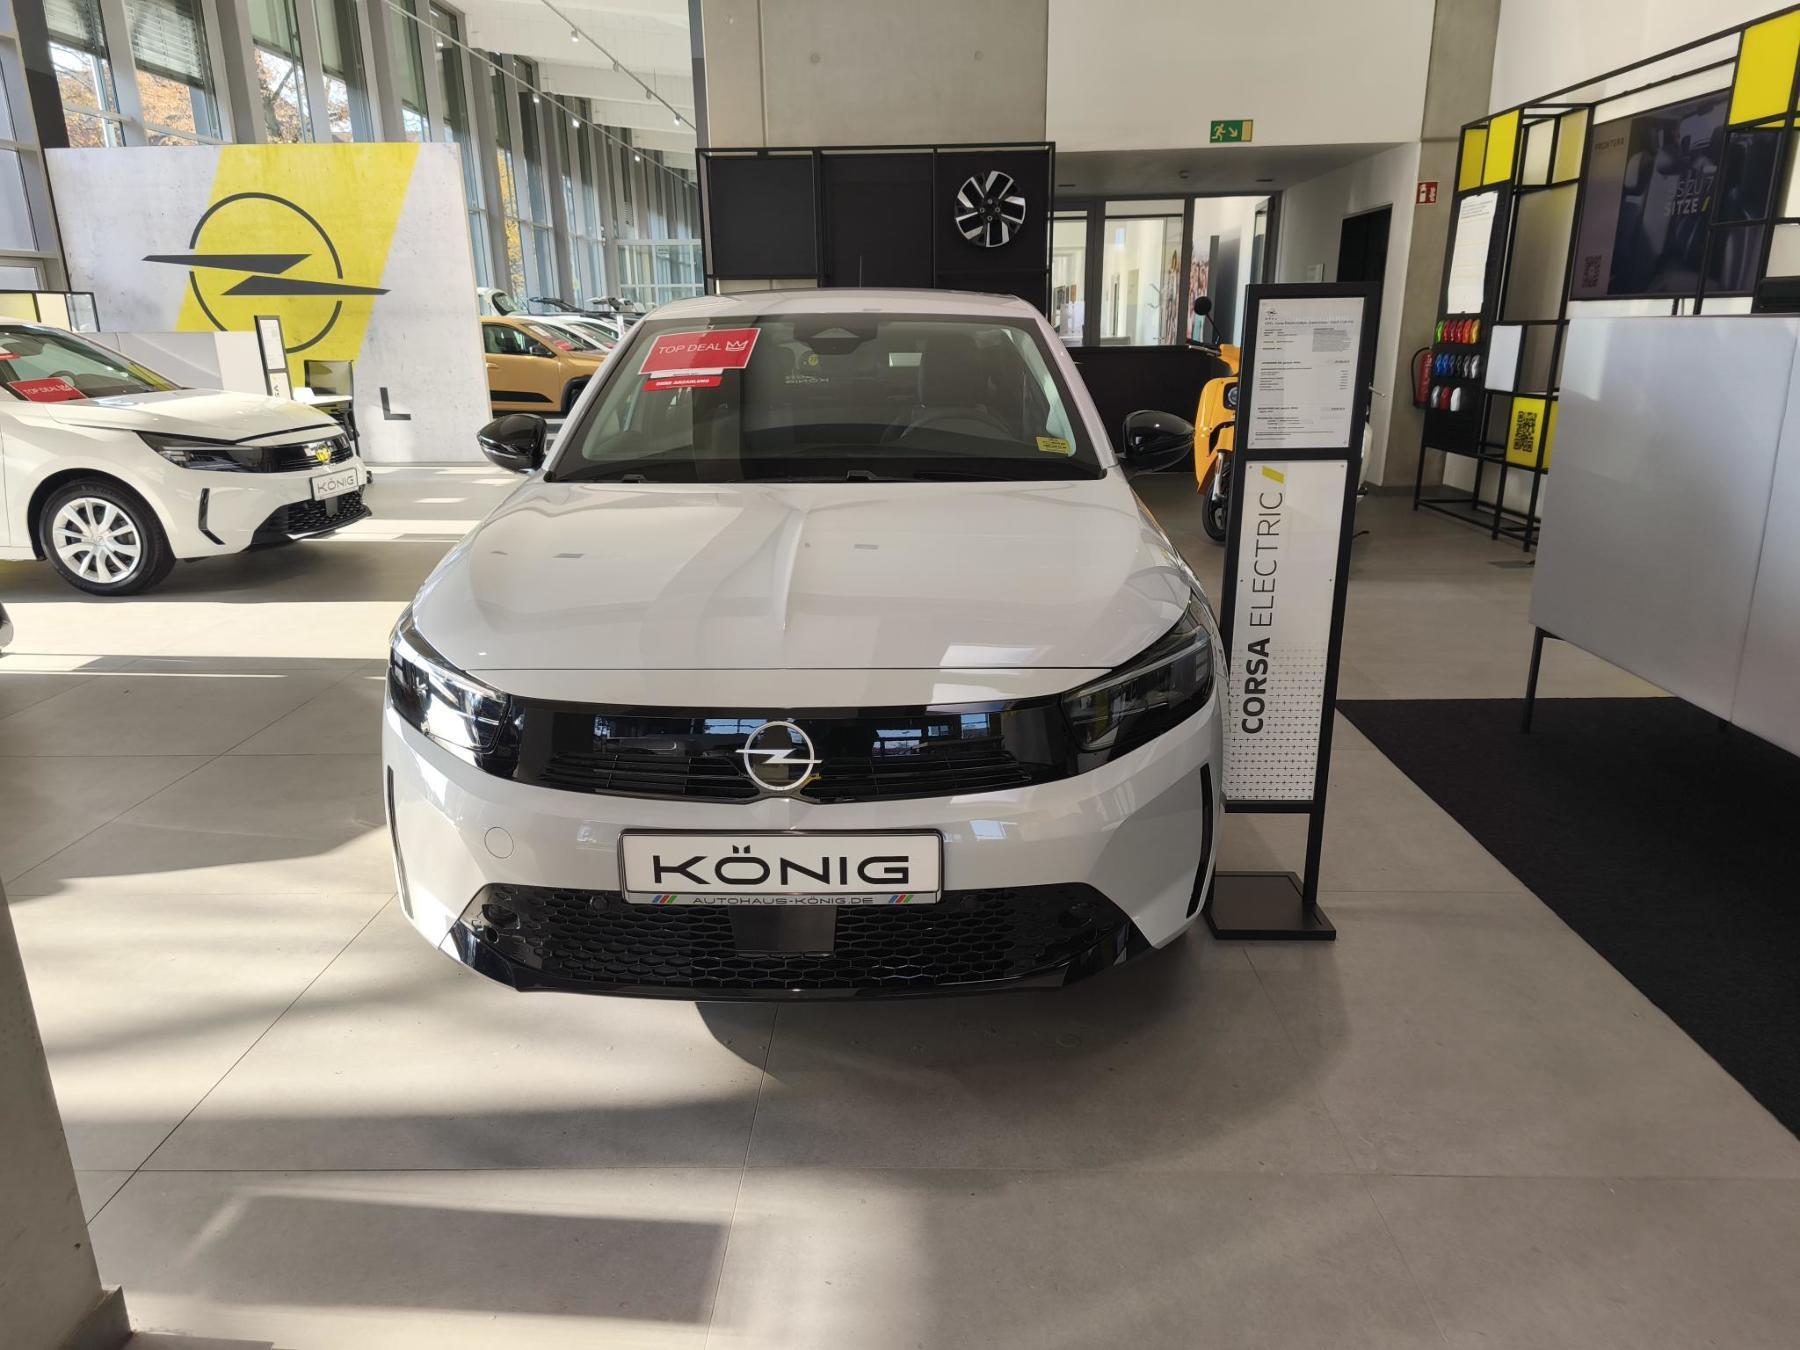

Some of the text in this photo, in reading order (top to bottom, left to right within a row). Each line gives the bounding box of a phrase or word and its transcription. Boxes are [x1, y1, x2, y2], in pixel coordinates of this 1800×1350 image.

[1664, 198, 1699, 217] SITZE
[658, 342, 722, 354] TOP DEAL
[317, 475, 354, 493] KÖNIG
[1242, 492, 1283, 734] CORSA ELECTRIC
[653, 845, 909, 886] KÖNIG
[693, 896, 874, 905] AUTOHAUS-KÖNIG.DE
